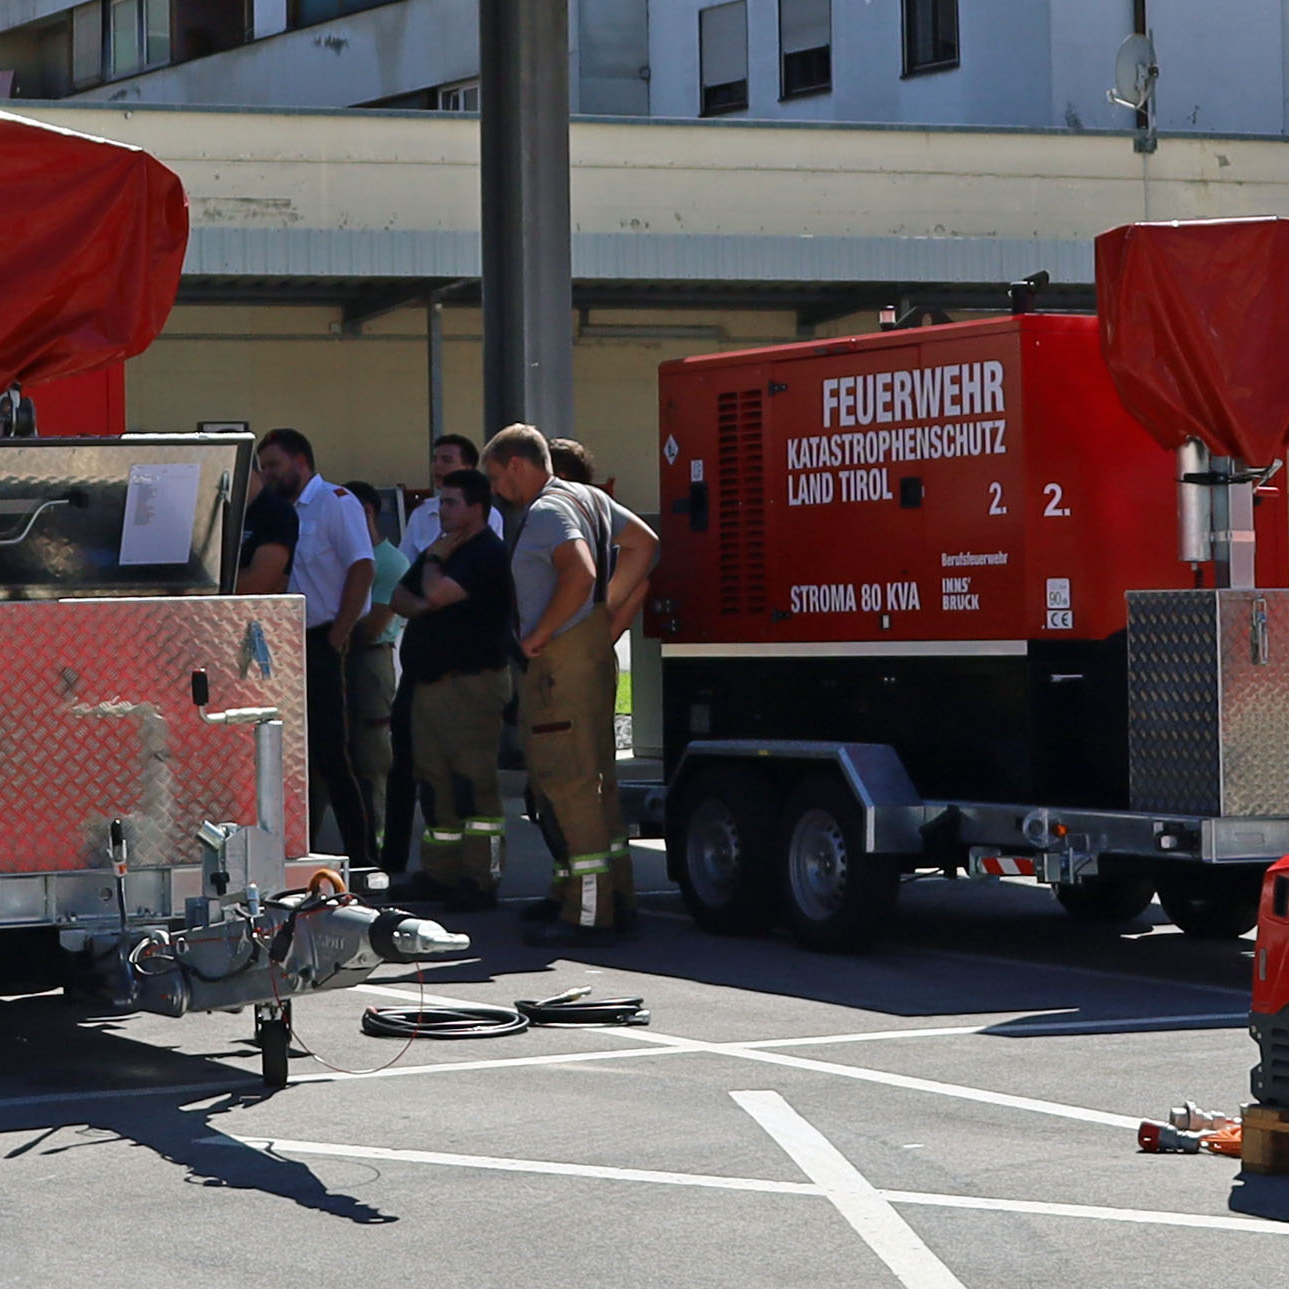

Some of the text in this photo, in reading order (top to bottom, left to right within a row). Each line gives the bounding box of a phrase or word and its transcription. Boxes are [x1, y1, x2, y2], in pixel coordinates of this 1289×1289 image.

[824, 360, 1005, 428] FEUERWEHR
[788, 419, 1005, 470] KATASTROPHENSCHUTZ
[789, 468, 892, 505] LAND TIROL
[990, 483, 1006, 515] 2.
[1044, 484, 1070, 516] 2.
[791, 582, 920, 612] STROMA 80 KVA
[943, 595, 979, 610] BRUCK
